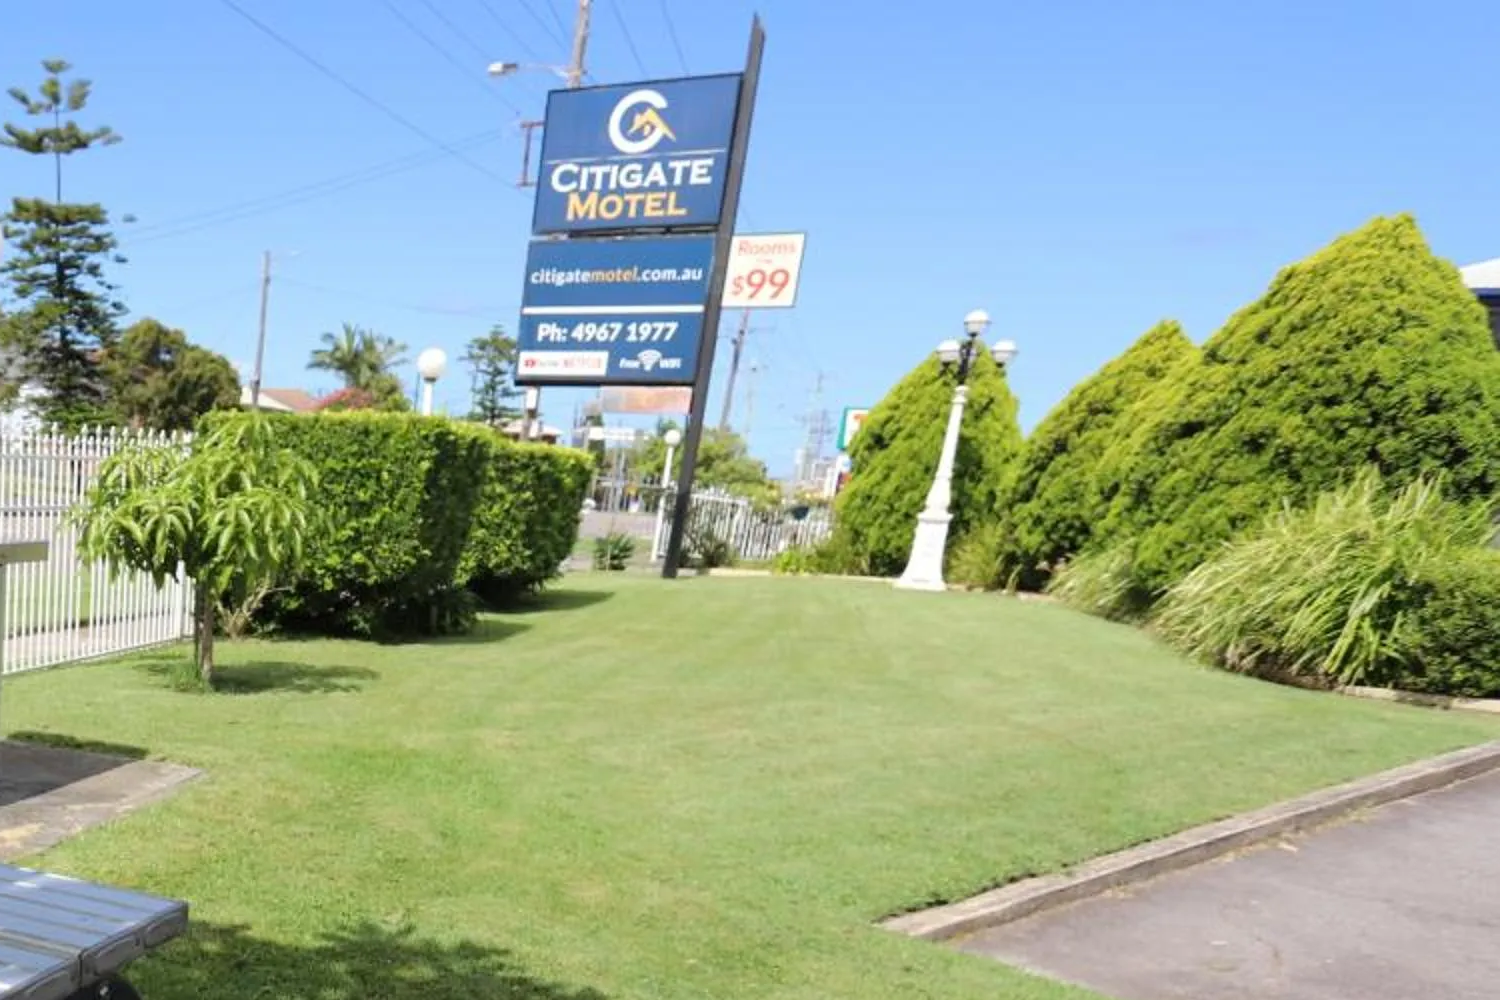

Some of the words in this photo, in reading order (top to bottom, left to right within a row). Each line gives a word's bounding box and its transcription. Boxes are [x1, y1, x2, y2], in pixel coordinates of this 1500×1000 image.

[551, 158, 714, 192] CITIGATE
[566, 191, 688, 222] MOTEL
[738, 239, 797, 256] Rooms
[531, 265, 703, 287] citigatemotel.com.au
[731, 268, 790, 300] $99
[536, 322, 568, 342] Ph:
[570, 321, 623, 342] 4967
[625, 321, 679, 342] 1977
